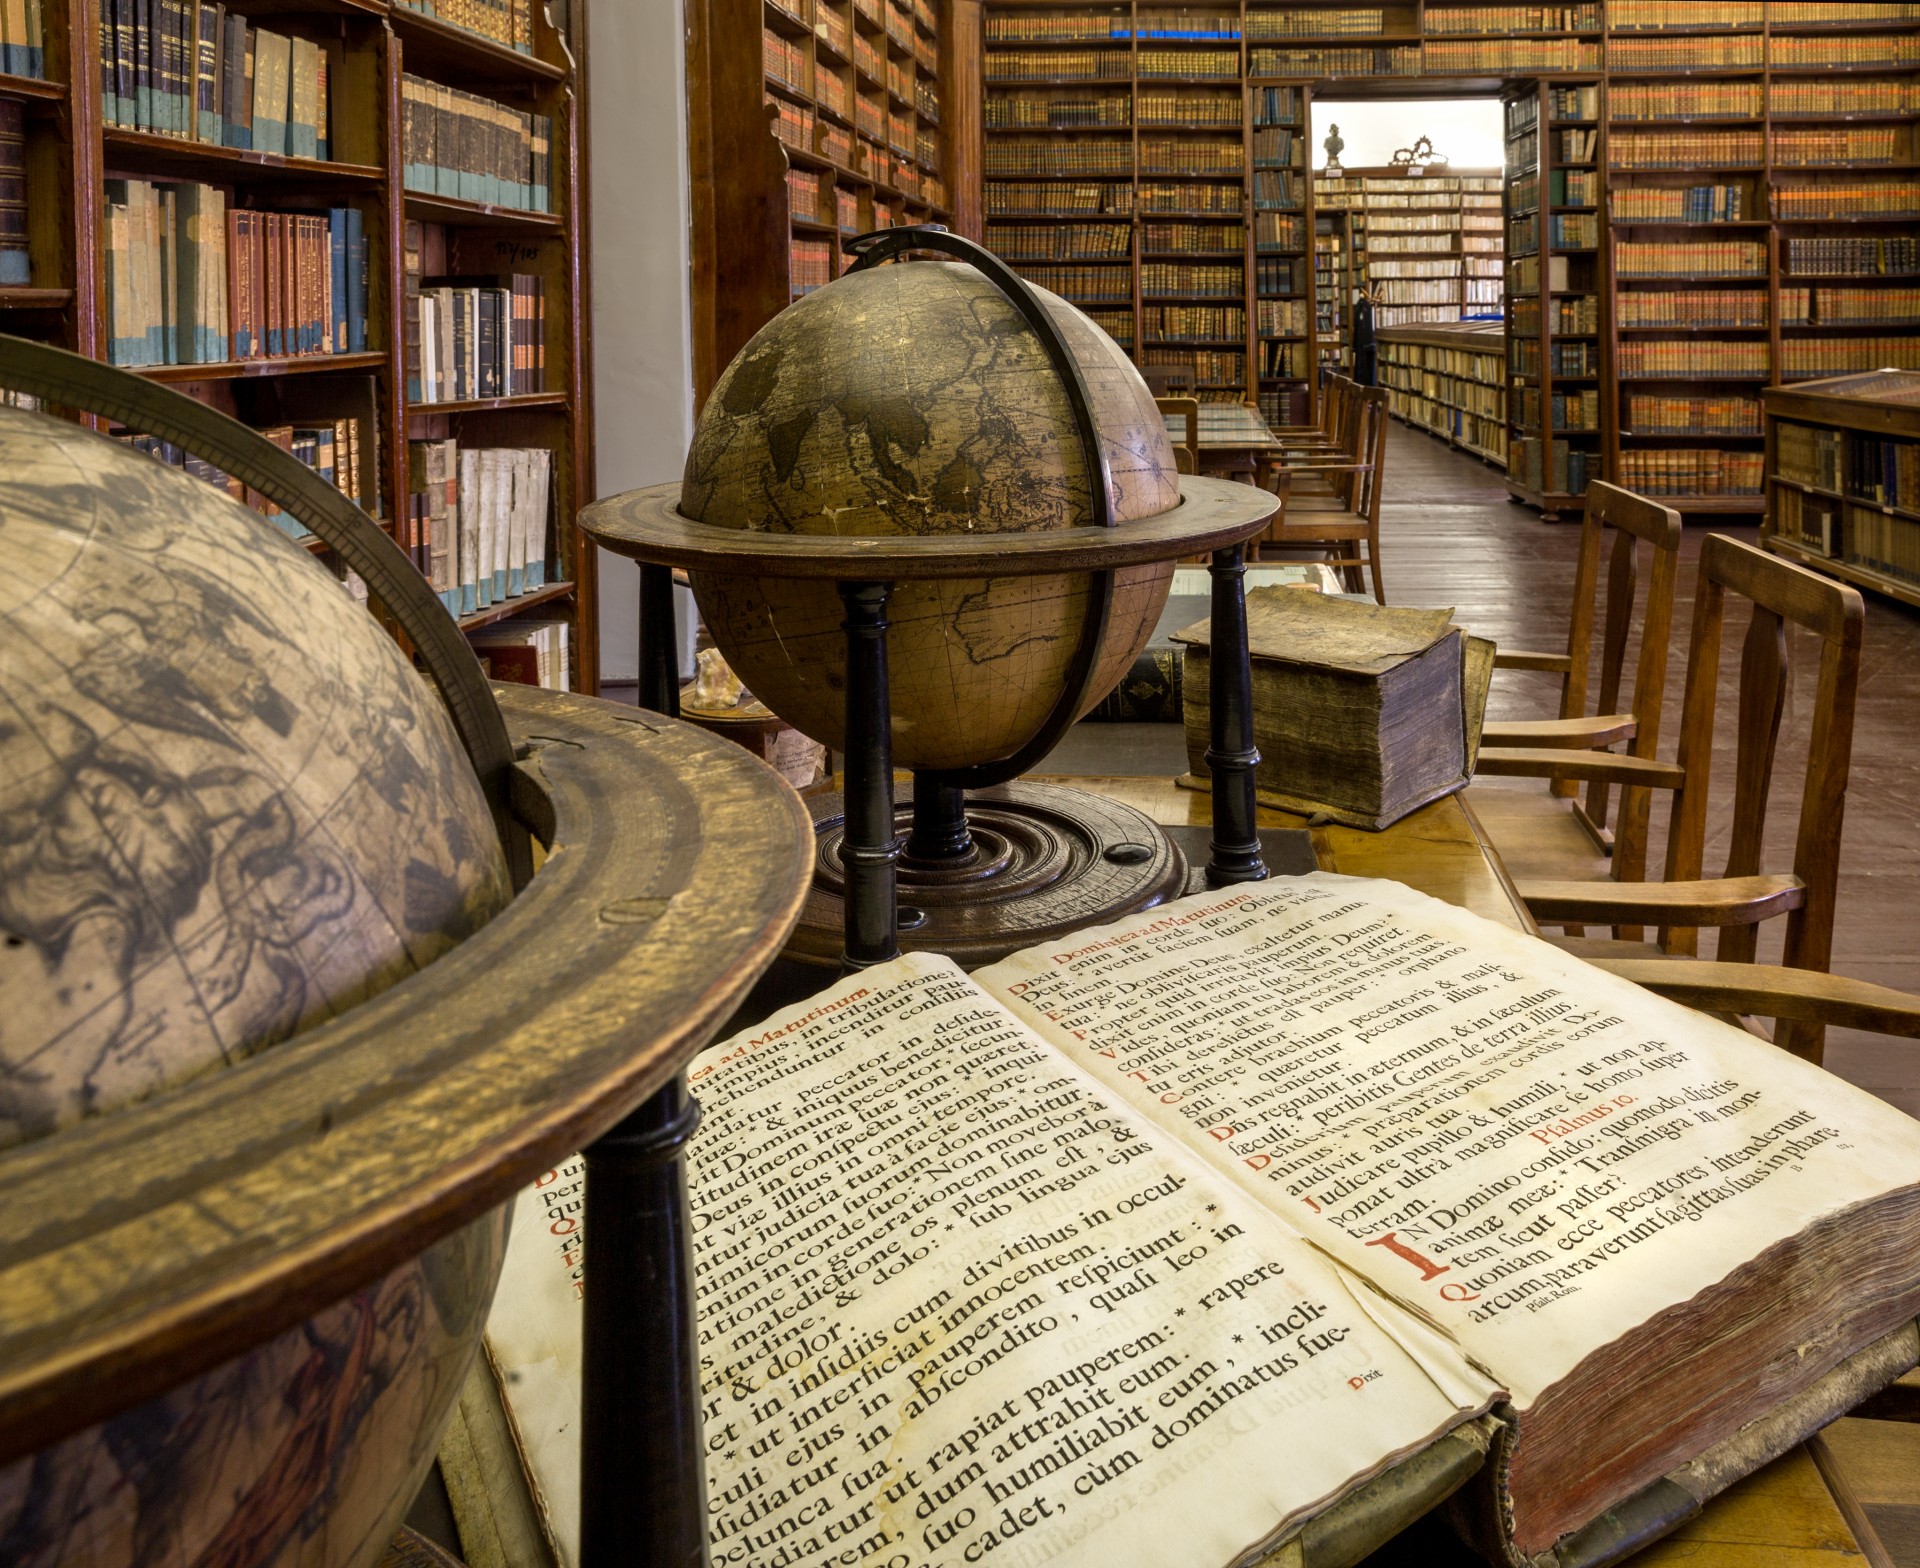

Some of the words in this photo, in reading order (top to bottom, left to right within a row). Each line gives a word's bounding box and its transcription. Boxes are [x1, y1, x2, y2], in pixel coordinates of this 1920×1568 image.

[1007, 971, 1061, 996] Dixit
[1069, 953, 1113, 972] enim
[1146, 928, 1193, 945] corde
[1044, 992, 1117, 1022] Exurge
[1114, 965, 1190, 995] Domine
[1244, 919, 1315, 955] exaltetur
[1051, 932, 1140, 965] Dominica
[1139, 924, 1163, 935] ad
[1091, 952, 1153, 976] avertit
[1155, 935, 1214, 953] faciem
[1266, 905, 1288, 917] ne
[827, 970, 956, 1025] tribulatione?
[1070, 1006, 1148, 1041] Propter
[1155, 988, 1198, 1009] quid
[1197, 967, 1274, 992] irritavit
[1276, 946, 1332, 970] impius
[1089, 1028, 1135, 1050] dixit
[1137, 1009, 1185, 1031] enim
[1209, 984, 1260, 1003] corde
[1293, 959, 1337, 972] Non
[1114, 998, 1138, 1010] ne
[1126, 1059, 1180, 1083] Tibi
[1398, 947, 1467, 975] orphano
[1170, 1001, 1251, 1034] quoniam
[1273, 967, 1348, 996] laborem
[1366, 934, 1433, 962] dolorem
[1230, 1015, 1254, 1027] ut
[1356, 956, 1411, 978] manus
[720, 1046, 748, 1064] ad
[805, 993, 914, 1051] incenditur
[1160, 1061, 1246, 1104] Contere
[1247, 1026, 1344, 1066] brachium
[1348, 989, 1435, 1029] peccatoris
[1354, 1004, 1440, 1044] peccatum
[1497, 1041, 1565, 1068] cordis
[1566, 1016, 1624, 1041] eorum
[792, 1075, 878, 1119] iniquus
[797, 1051, 890, 1103] peccator
[903, 1075, 951, 1101] non
[1177, 1064, 1214, 1083] eris
[1257, 1081, 1345, 1123] regnabit
[1312, 1083, 1395, 1127] peribitis
[1392, 1054, 1461, 1086] Gentes
[1460, 1043, 1485, 1058] de
[1483, 1022, 1531, 1047] terra
[720, 1108, 847, 1174] Dominum
[1194, 1107, 1237, 1129] non
[1300, 1159, 1401, 1214] Judicare
[1401, 1126, 1473, 1165] pupillo
[1576, 1062, 1602, 1076] ut
[1601, 1049, 1640, 1066] non
[1327, 1187, 1395, 1228] ponat
[1395, 1158, 1453, 1189] ultrà
[1454, 1104, 1569, 1161] magnificare
[1583, 1069, 1643, 1093] homo
[754, 1189, 843, 1246] judicia
[845, 1163, 888, 1190] tua
[904, 1122, 960, 1156] facie
[771, 1172, 832, 1212] illius
[867, 1116, 930, 1157] omni
[1016, 1165, 1101, 1204] lingua
[1105, 1142, 1153, 1165] ejus
[1286, 1151, 1366, 1196] audivit
[1369, 1127, 1423, 1154] auris
[1425, 1175, 1521, 1231] Domino
[1599, 1096, 1686, 1139] quomodo
[1681, 1080, 1739, 1102] dicitis
[692, 1192, 753, 1231] Deus
[695, 1282, 761, 1324] enim
[794, 1218, 866, 1266] corde
[922, 1150, 985, 1183] Non
[985, 1107, 1089, 1154] movebor
[790, 1268, 822, 1290] in
[827, 1165, 999, 1273] generationem
[910, 1216, 938, 1238] os
[950, 1169, 1045, 1218] plenum
[1440, 1250, 1554, 1302] Quoniam
[1557, 1219, 1604, 1251] ecce
[1606, 1166, 1709, 1224] peccatores
[1704, 1110, 1816, 1172] intenderunt
[1451, 1246, 1501, 1268] tem
[1542, 1217, 1665, 1288] paraverunt
[749, 1397, 785, 1426] in
[893, 1290, 954, 1334] cum
[963, 1224, 1079, 1287] divitibus
[856, 1425, 893, 1455] in
[1163, 1246, 1208, 1273] leo
[1210, 1224, 1246, 1244] in
[747, 1428, 784, 1459] ut
[788, 1330, 936, 1434] interficiat
[786, 1423, 845, 1467] ejus
[858, 1393, 893, 1420] in
[906, 1293, 1046, 1407] pauperem
[882, 1470, 922, 1504] ut
[926, 1400, 1021, 1475] rapiat
[1198, 1262, 1285, 1311] rapere
[1347, 1370, 1383, 1390] Dixit
[915, 1461, 988, 1520] dum
[991, 1388, 1115, 1464] attrahit
[981, 1406, 1150, 1507] humiliabit
[1074, 1450, 1143, 1496] cùm
[1152, 1353, 1299, 1450] dominatus
